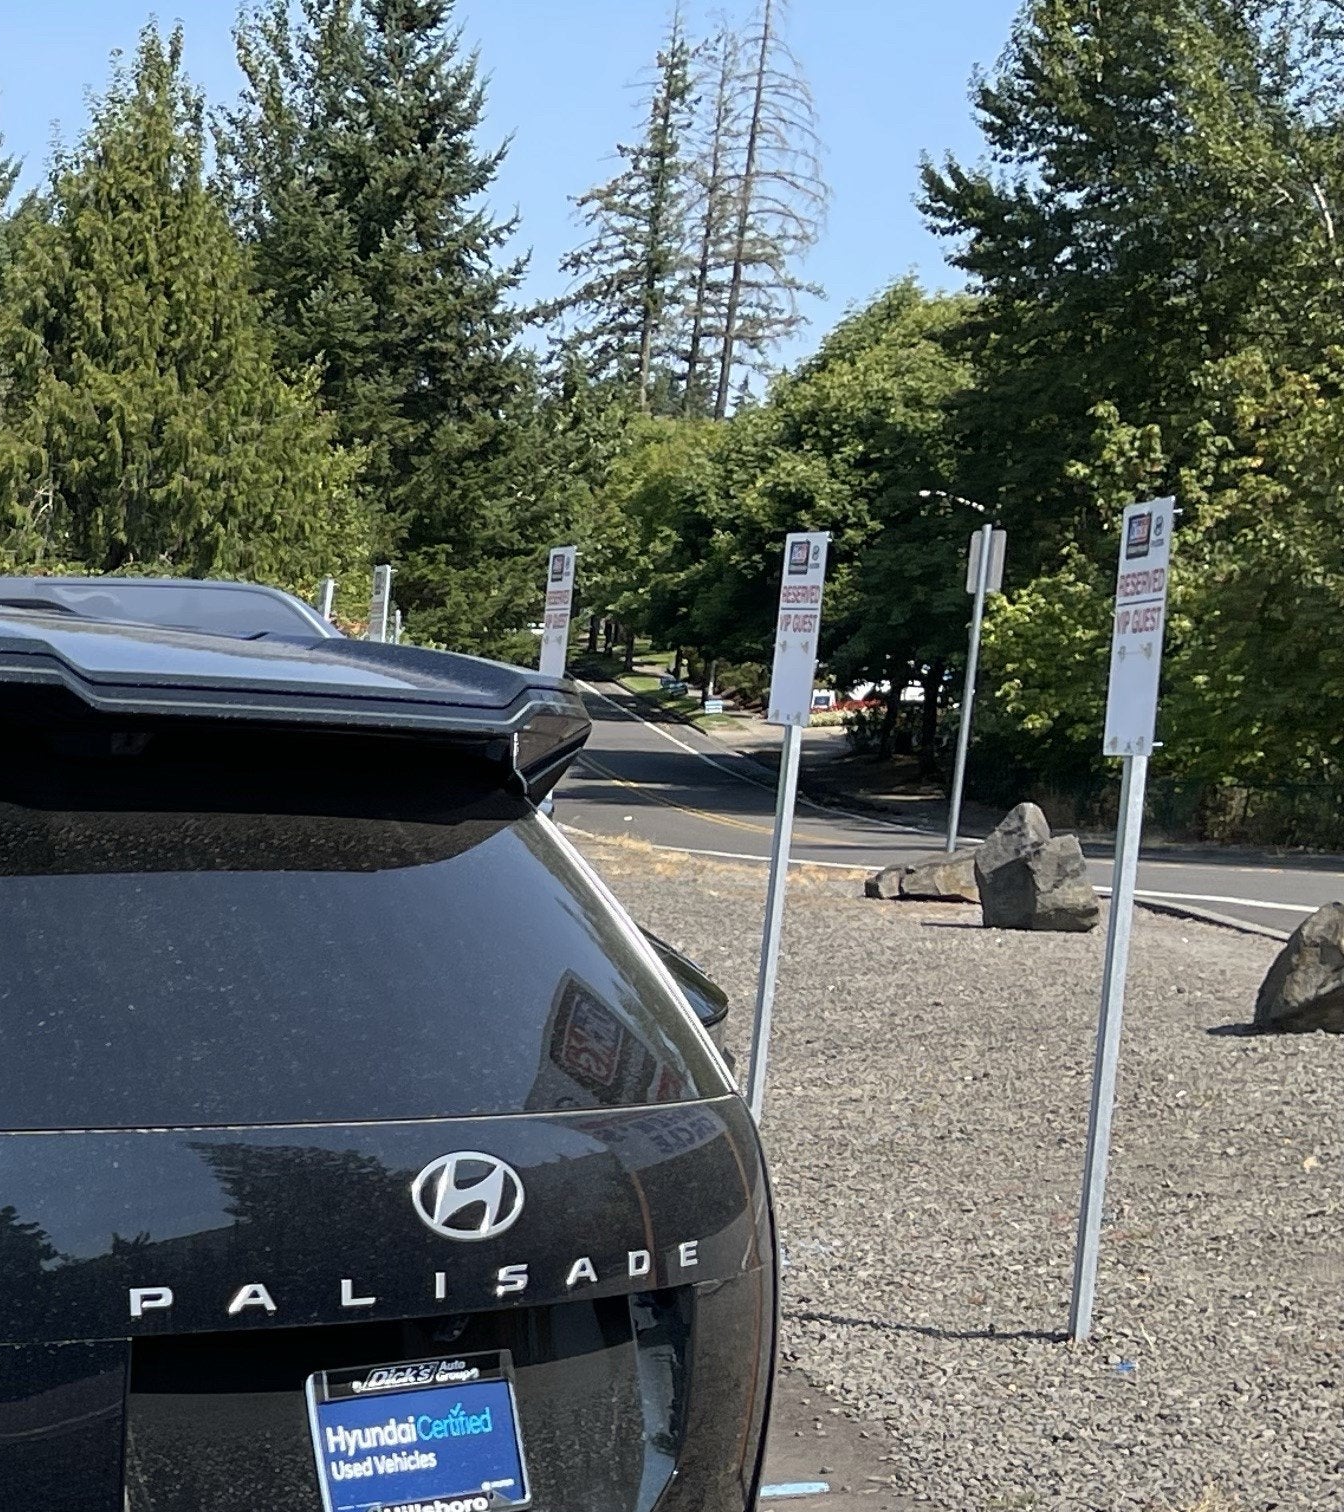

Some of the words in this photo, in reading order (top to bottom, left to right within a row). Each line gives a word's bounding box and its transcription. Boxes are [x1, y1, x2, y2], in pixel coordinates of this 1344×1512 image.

[781, 585, 820, 603] RESERVED
[1117, 568, 1165, 597] RESERVED
[779, 613, 792, 632] VIP
[793, 613, 818, 633] GUEST
[1116, 610, 1130, 634] VIP
[1132, 607, 1162, 634] GUEST
[128, 1239, 700, 1317] PALISADE
[367, 1365, 432, 1388] Dick's
[439, 1360, 466, 1372] Auto
[435, 1369, 470, 1382] Group
[325, 1415, 417, 1457] Hyundai
[416, 1404, 494, 1441] Certified
[330, 1456, 374, 1481] Used
[373, 1450, 438, 1475] Vehicles
